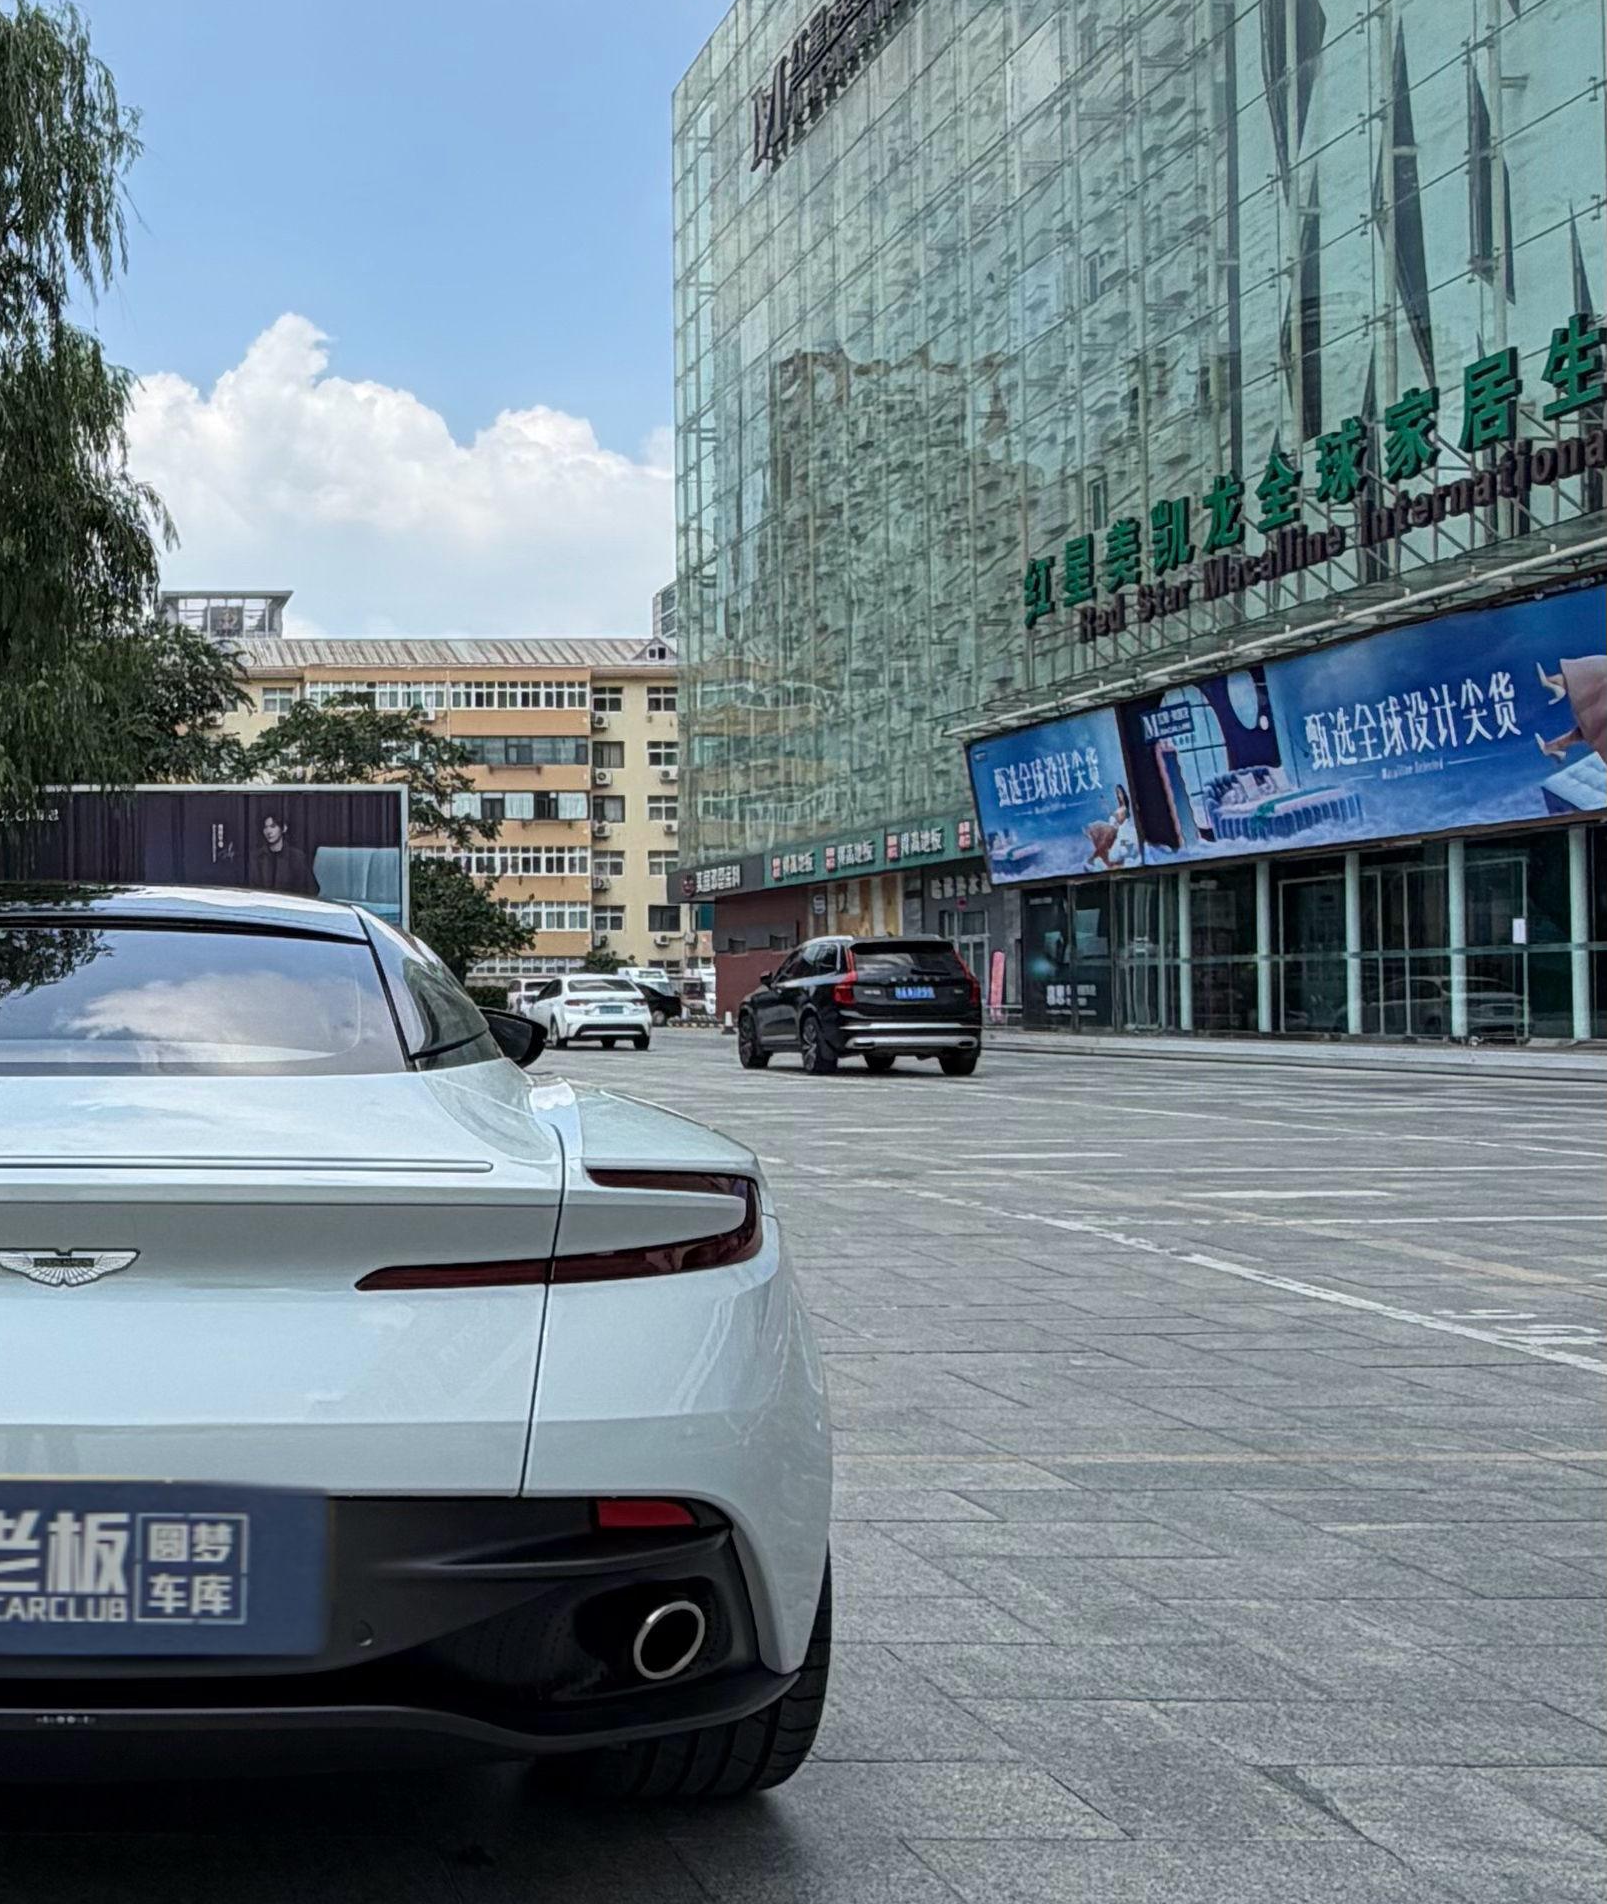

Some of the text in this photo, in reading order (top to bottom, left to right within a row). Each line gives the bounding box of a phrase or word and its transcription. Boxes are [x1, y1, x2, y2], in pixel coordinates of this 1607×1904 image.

[1023, 312, 1607, 630] 红星美凯龙全球家居生
[1079, 592, 1125, 644] Red
[1137, 579, 1193, 624] Star
[1203, 523, 1346, 602] Macalline
[1304, 670, 1522, 770] 甄选全球设计尖货
[147, 1573, 232, 1615] 车库
